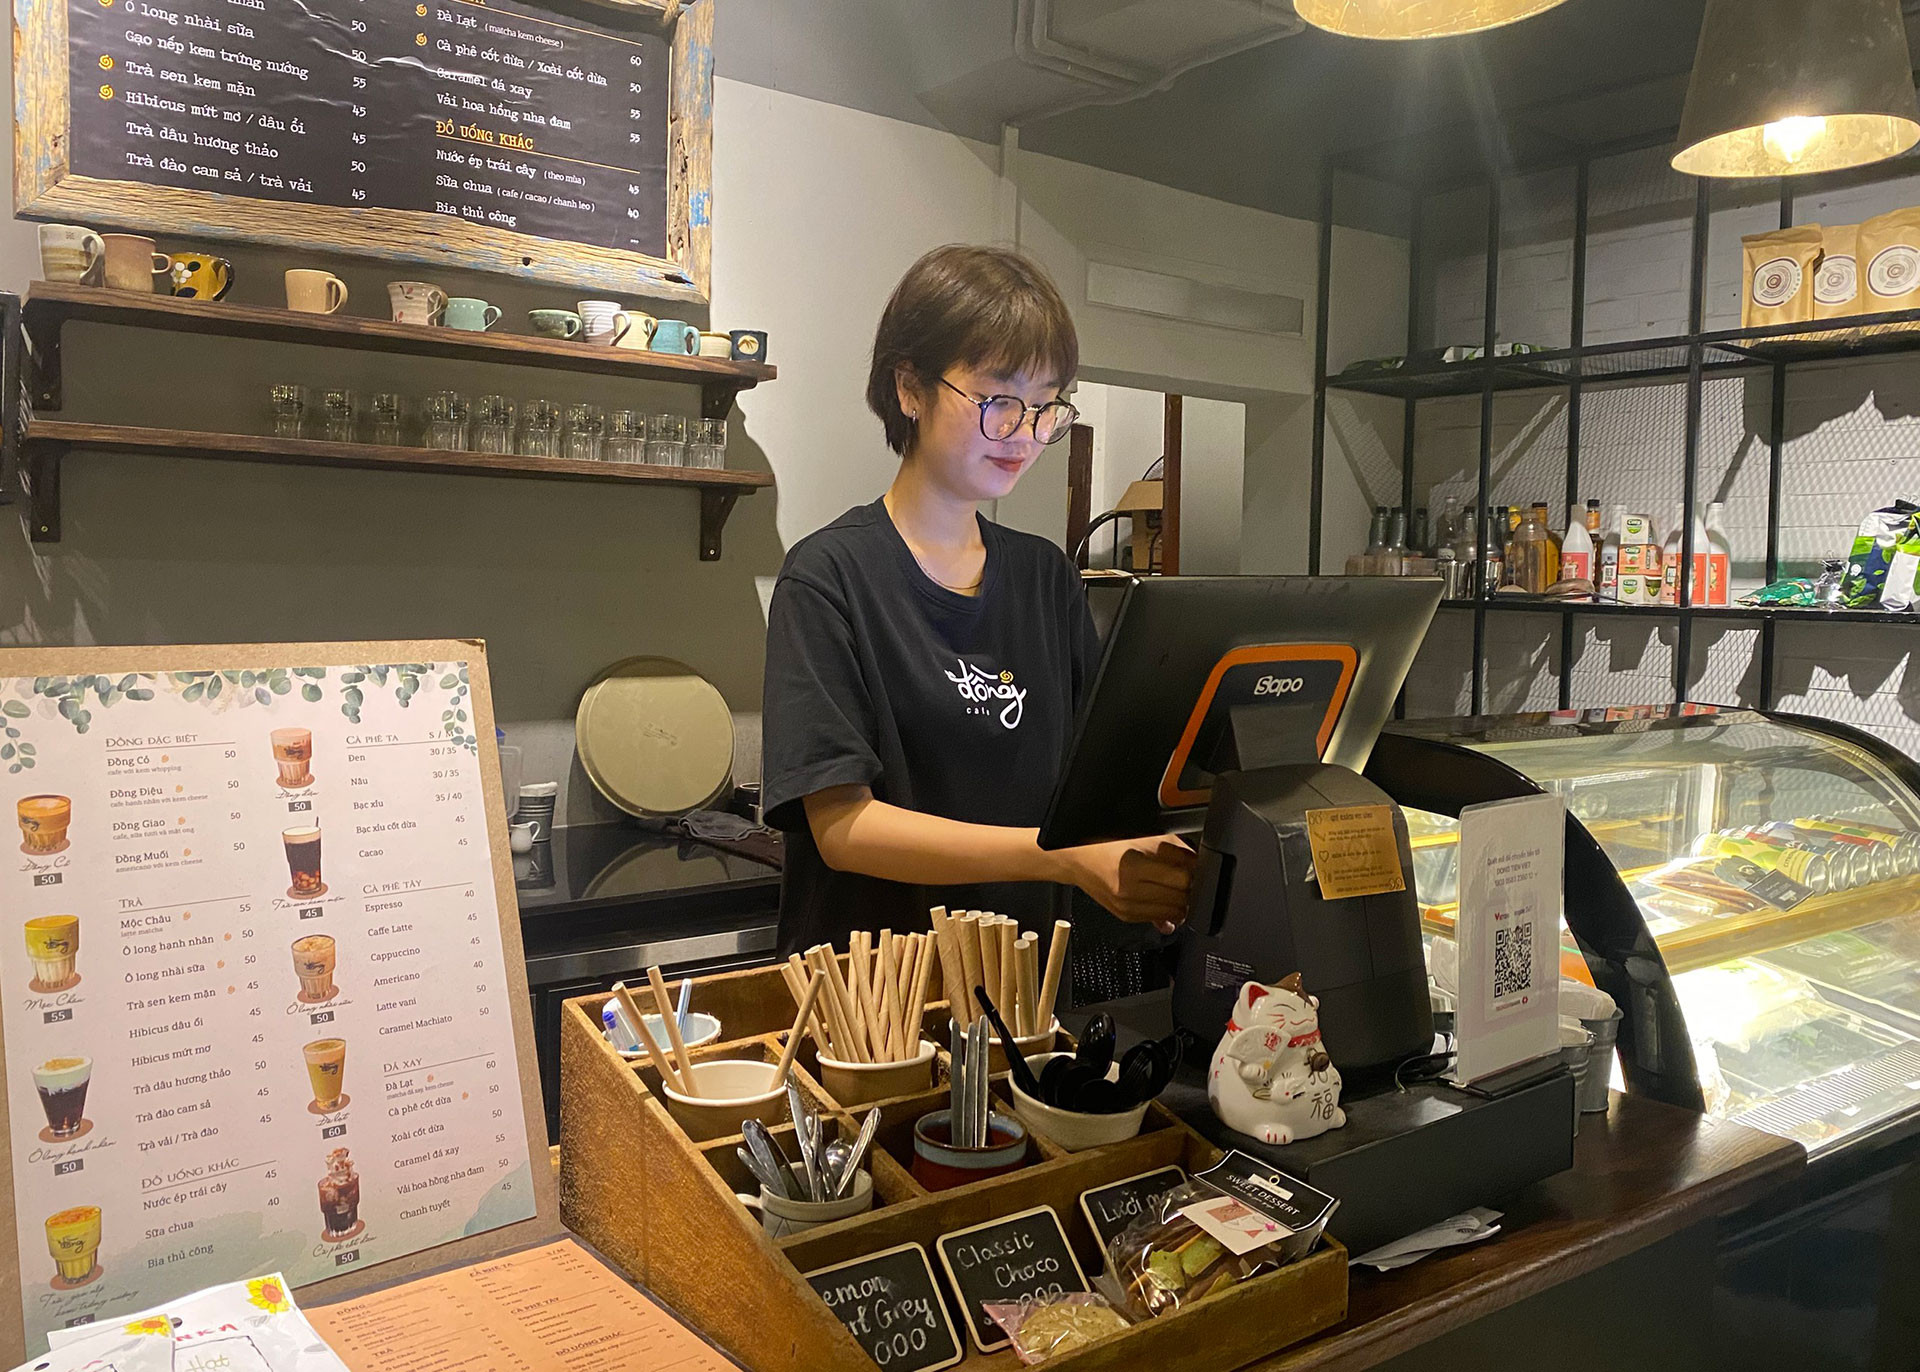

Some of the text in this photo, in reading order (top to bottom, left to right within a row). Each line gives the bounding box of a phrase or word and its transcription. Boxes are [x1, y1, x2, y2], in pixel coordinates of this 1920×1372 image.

[141, 3, 178, 25] long
[184, 14, 221, 31] nhài
[228, 23, 254, 38] sữa
[351, 51, 366, 61] 50
[352, 20, 366, 32] 50
[437, 10, 452, 22] Đà
[457, 14, 477, 28] Lạt
[630, 56, 641, 66] 60
[126, 30, 366, 88] Gạo nếp kem trứng nướng 55
[437, 40, 641, 93] Cà phê cốt dừa / Xoài cốt dừa 50
[126, 61, 366, 116] Trà sen kem mặn 45
[437, 68, 640, 119] Caramel đá xay 55
[126, 92, 366, 144] Hibicus mứt mơ / dâu ổi 45
[437, 93, 640, 143] Vải hoa hồng nha đam 55
[126, 122, 365, 172] Trà dâu hương thảo 50
[436, 119, 533, 149] ĐỒ UỐNG KHÁC
[126, 153, 365, 200] Trà đào cam sả / trà vải 45
[437, 150, 464, 163] Nước
[468, 154, 482, 168] ép
[486, 158, 512, 172] trái
[516, 164, 536, 178] cây
[629, 184, 639, 194] 45
[436, 175, 458, 188] Sữa
[463, 180, 492, 194] chua
[628, 208, 639, 218] 40
[436, 202, 516, 227] Bia thủ công
[1254, 676, 1303, 697] Sapo
[110, 780, 239, 798] Đồng Điệu 50
[359, 838, 468, 858] Cacao 45
[118, 897, 142, 908] TRÀ
[121, 903, 251, 928] Mộc Châu 55
[365, 901, 402, 912] Espresso
[368, 926, 389, 936] Caffe
[392, 924, 412, 933] Latte
[370, 936, 480, 962] Cappuccino 45
[374, 960, 483, 986] Americano 40
[126, 1000, 144, 1010] Trà
[148, 998, 166, 1007] sen
[168, 994, 190, 1004] kem
[247, 980, 258, 989] 45
[376, 984, 486, 1011] Latte vani 50
[52, 1011, 65, 1021] 55
[379, 1007, 489, 1035] Caramel Machiato 50
[133, 1060, 266, 1094] Trà dâu hương thảo 50
[136, 1112, 153, 1123] Trà
[156, 1108, 174, 1119] đào
[177, 1104, 198, 1114] cam
[257, 1087, 269, 1096] 45
[329, 1127, 340, 1136] 60
[394, 1133, 505, 1168] Caramel đá xay 55
[1226, 1174, 1260, 1193] SWEET
[1258, 1191, 1300, 1216] DESSERT
[146, 1196, 279, 1239] Sữa chua 40
[148, 1244, 214, 1268] Bia thủ công
[957, 1231, 1034, 1270] Classic
[994, 1257, 1059, 1288] Choco
[823, 1276, 891, 1306] emon
[875, 1299, 936, 1329] Grey
